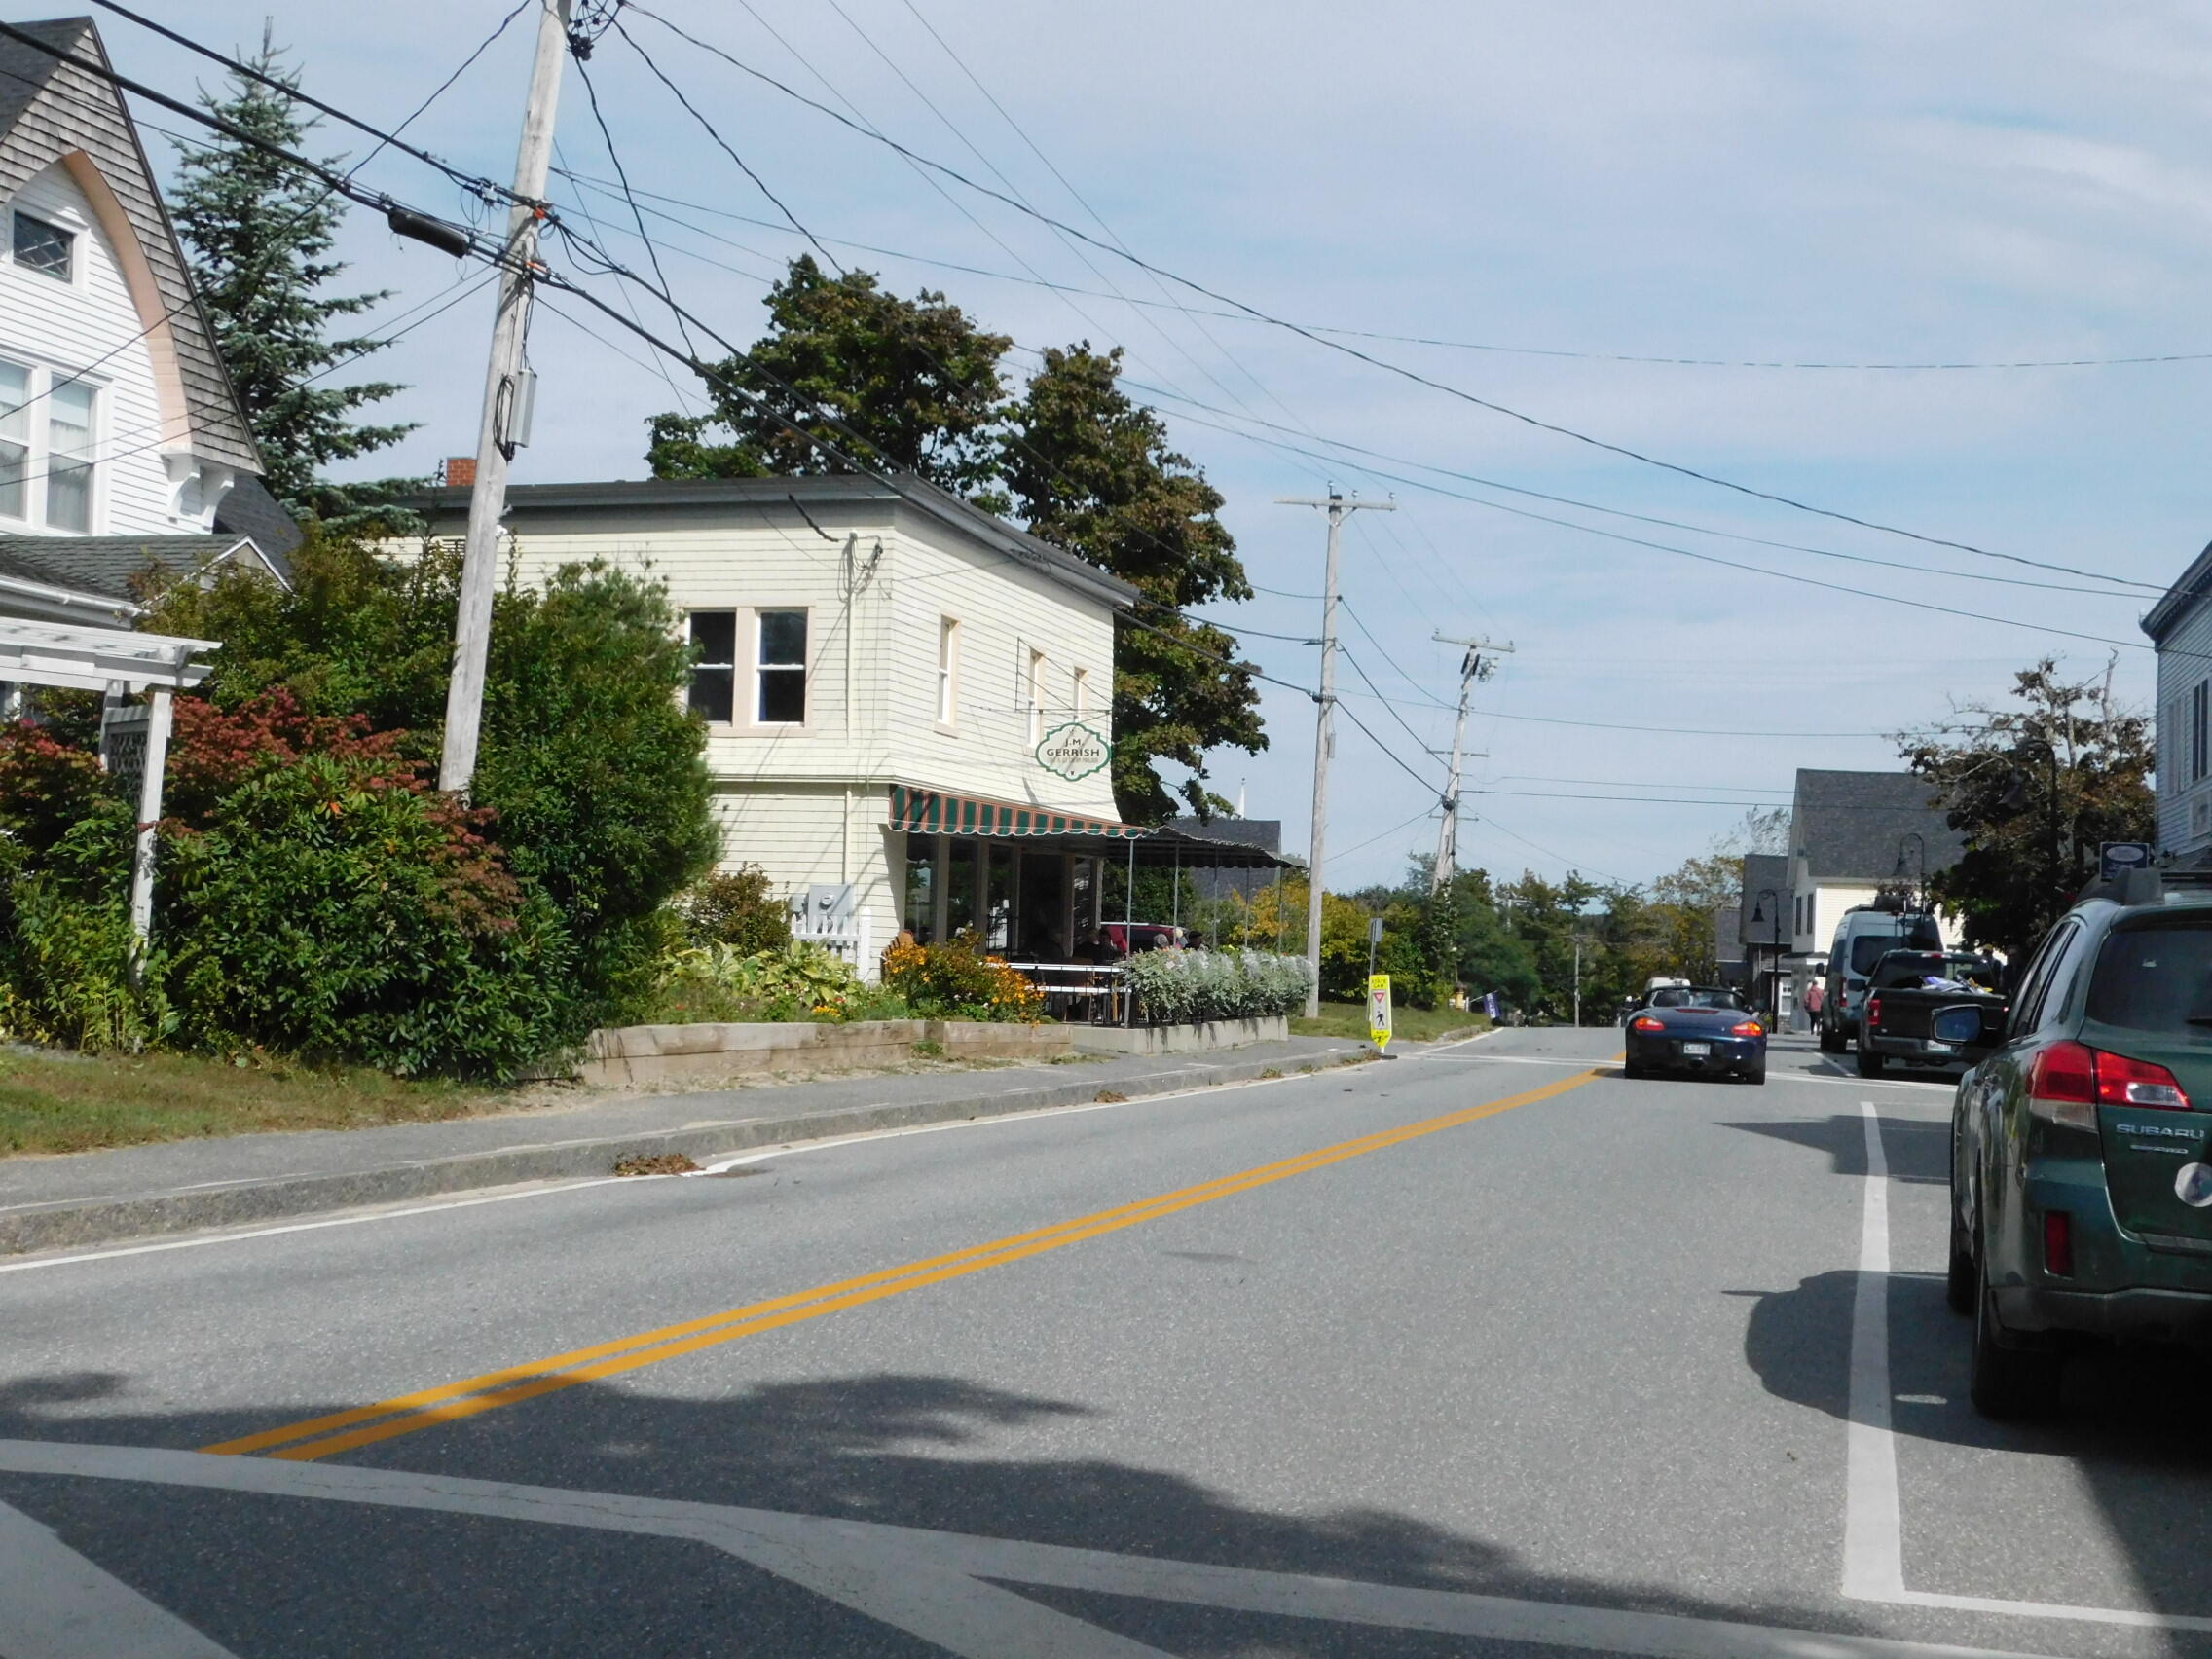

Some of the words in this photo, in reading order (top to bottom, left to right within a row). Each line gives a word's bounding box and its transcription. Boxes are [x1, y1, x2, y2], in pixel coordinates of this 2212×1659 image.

[1065, 738, 1085, 747] J.M.
[1046, 748, 1100, 756] GERRISH
[2116, 1123, 2205, 1139] SUBARU
